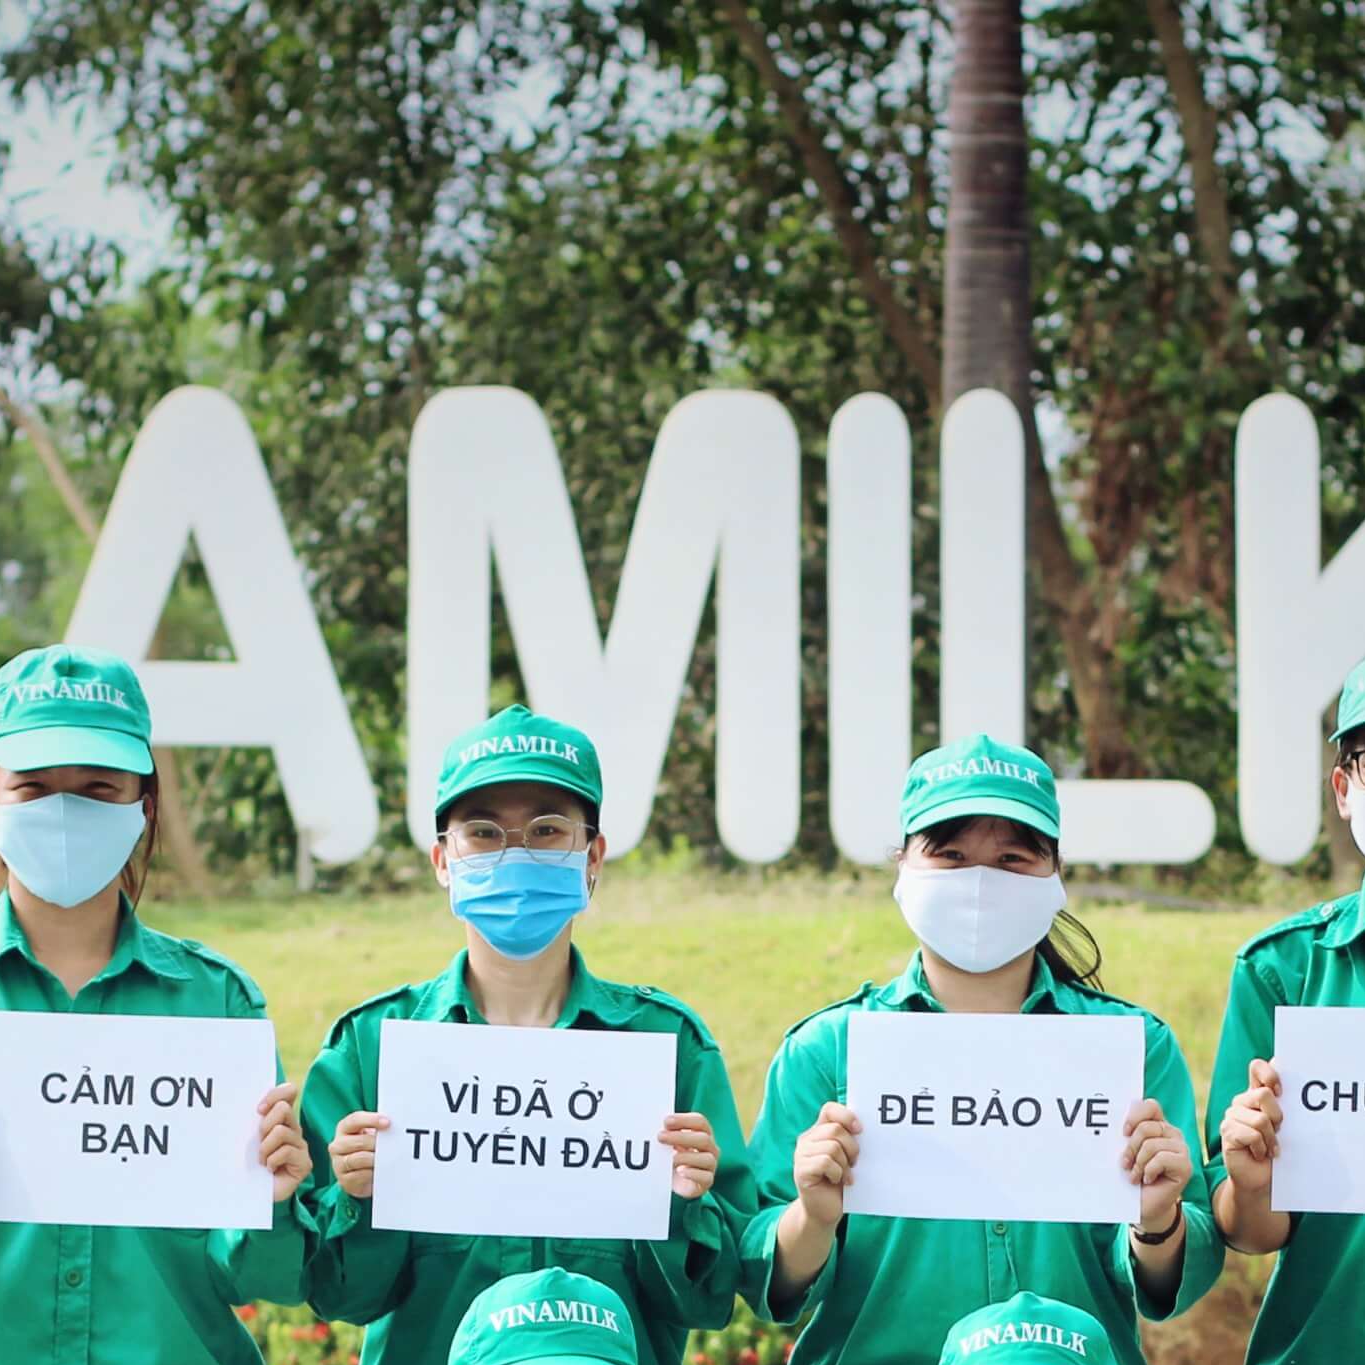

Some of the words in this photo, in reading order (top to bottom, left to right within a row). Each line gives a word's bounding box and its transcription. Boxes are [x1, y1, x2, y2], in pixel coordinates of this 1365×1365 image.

[12, 677, 129, 709] VINAMILK
[459, 734, 580, 766] VINAMILK
[923, 755, 1041, 788] VINAMILK
[41, 1065, 134, 1106] CẢM
[150, 1075, 213, 1109] ƠN
[442, 1075, 480, 1115] VÌ
[493, 1079, 553, 1119] ĐÃ
[567, 1081, 604, 1121] Ở
[878, 1086, 935, 1126] ĐỂ
[951, 1088, 1042, 1127] BẢO
[1056, 1092, 1110, 1136] VỆ
[81, 1122, 170, 1163] BẠN
[405, 1126, 547, 1167] TUYẾN
[560, 1130, 651, 1171] ĐẦU
[489, 1299, 620, 1334] VINAMILK
[959, 1321, 1088, 1357] VINAMILK
